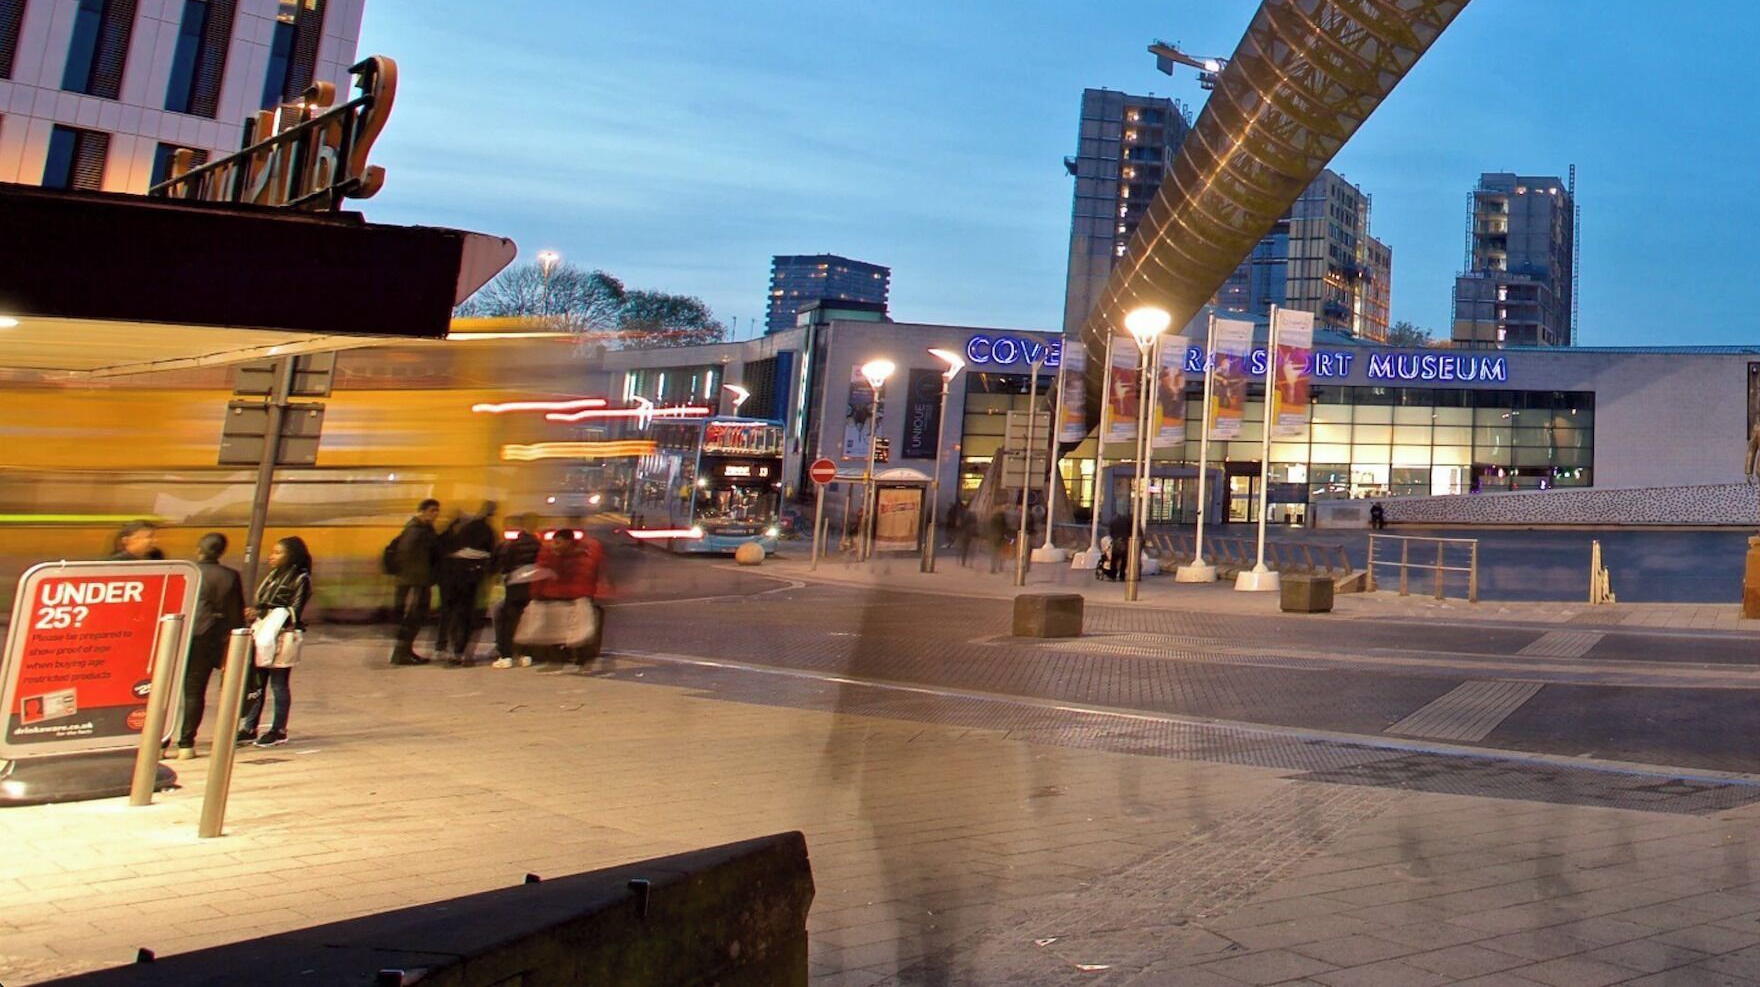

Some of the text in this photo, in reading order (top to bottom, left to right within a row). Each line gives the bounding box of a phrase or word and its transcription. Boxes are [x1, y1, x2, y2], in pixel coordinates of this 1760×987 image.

[1367, 353, 1507, 382] MUSEUM
[912, 404, 925, 448] UNIQUE
[41, 581, 144, 606] UNDER
[35, 606, 89, 630] 25?
[32, 634, 64, 642] Please
[67, 632, 78, 641] be
[80, 630, 121, 641] prepared
[29, 645, 112, 656] show proof of age
[26, 661, 54, 670] when
[55, 659, 87, 669] buying
[23, 671, 112, 684] restricted products
